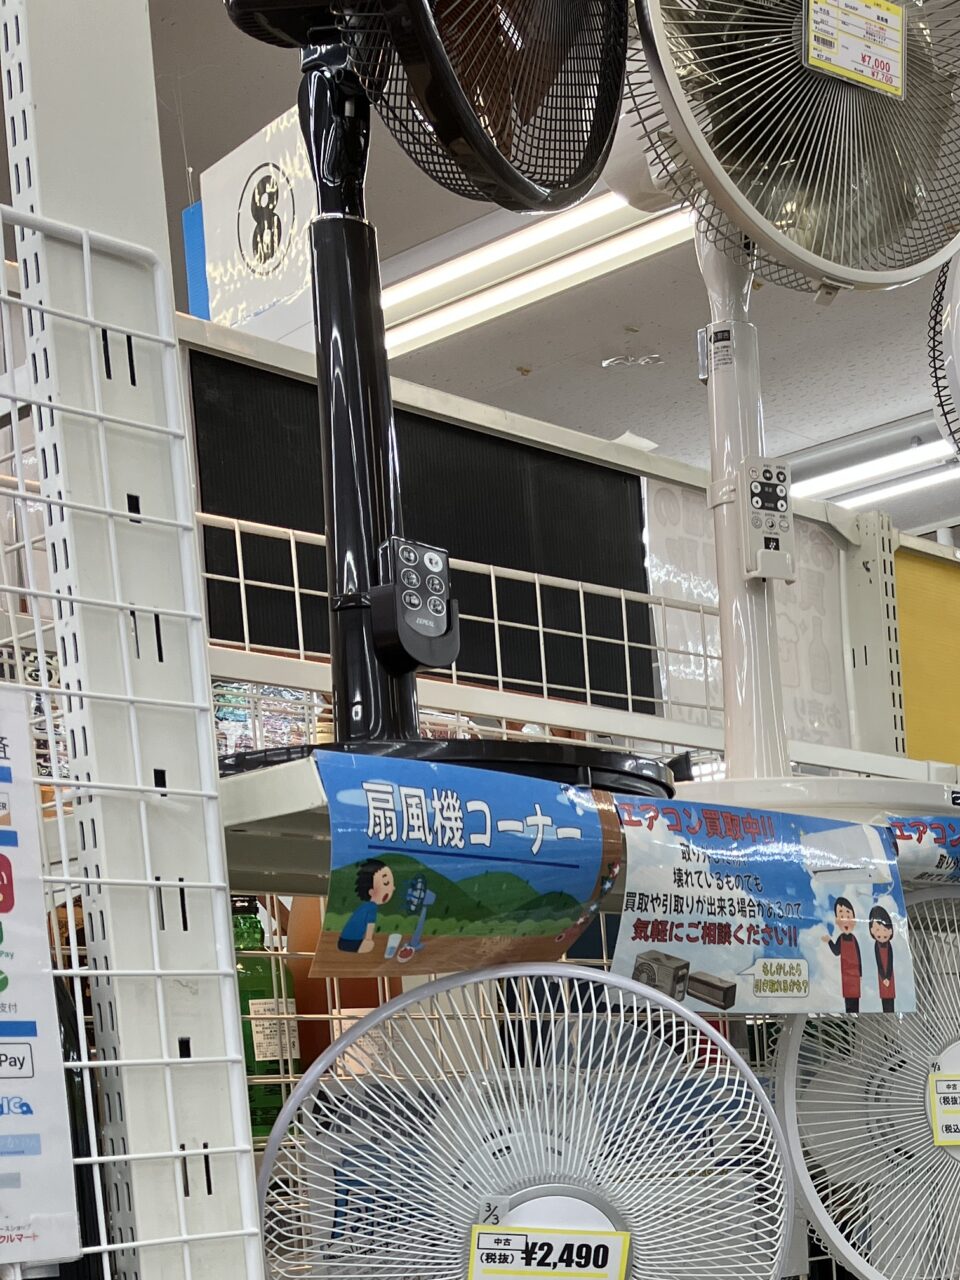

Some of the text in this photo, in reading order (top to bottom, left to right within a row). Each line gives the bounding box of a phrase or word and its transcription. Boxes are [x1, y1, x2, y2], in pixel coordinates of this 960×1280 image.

[861, 52, 891, 73] ¥7,000
[251, 175, 282, 265] 8
[361, 781, 582, 855] 扇風機コーナー
[617, 802, 776, 844] エアコン買取中!!
[632, 918, 798, 948] 気軽にご相談ください!!
[483, 1202, 500, 1226] 3/3
[480, 1241, 609, 1270] (税抜) ¥2,490
[494, 1238, 512, 1247] 中古
